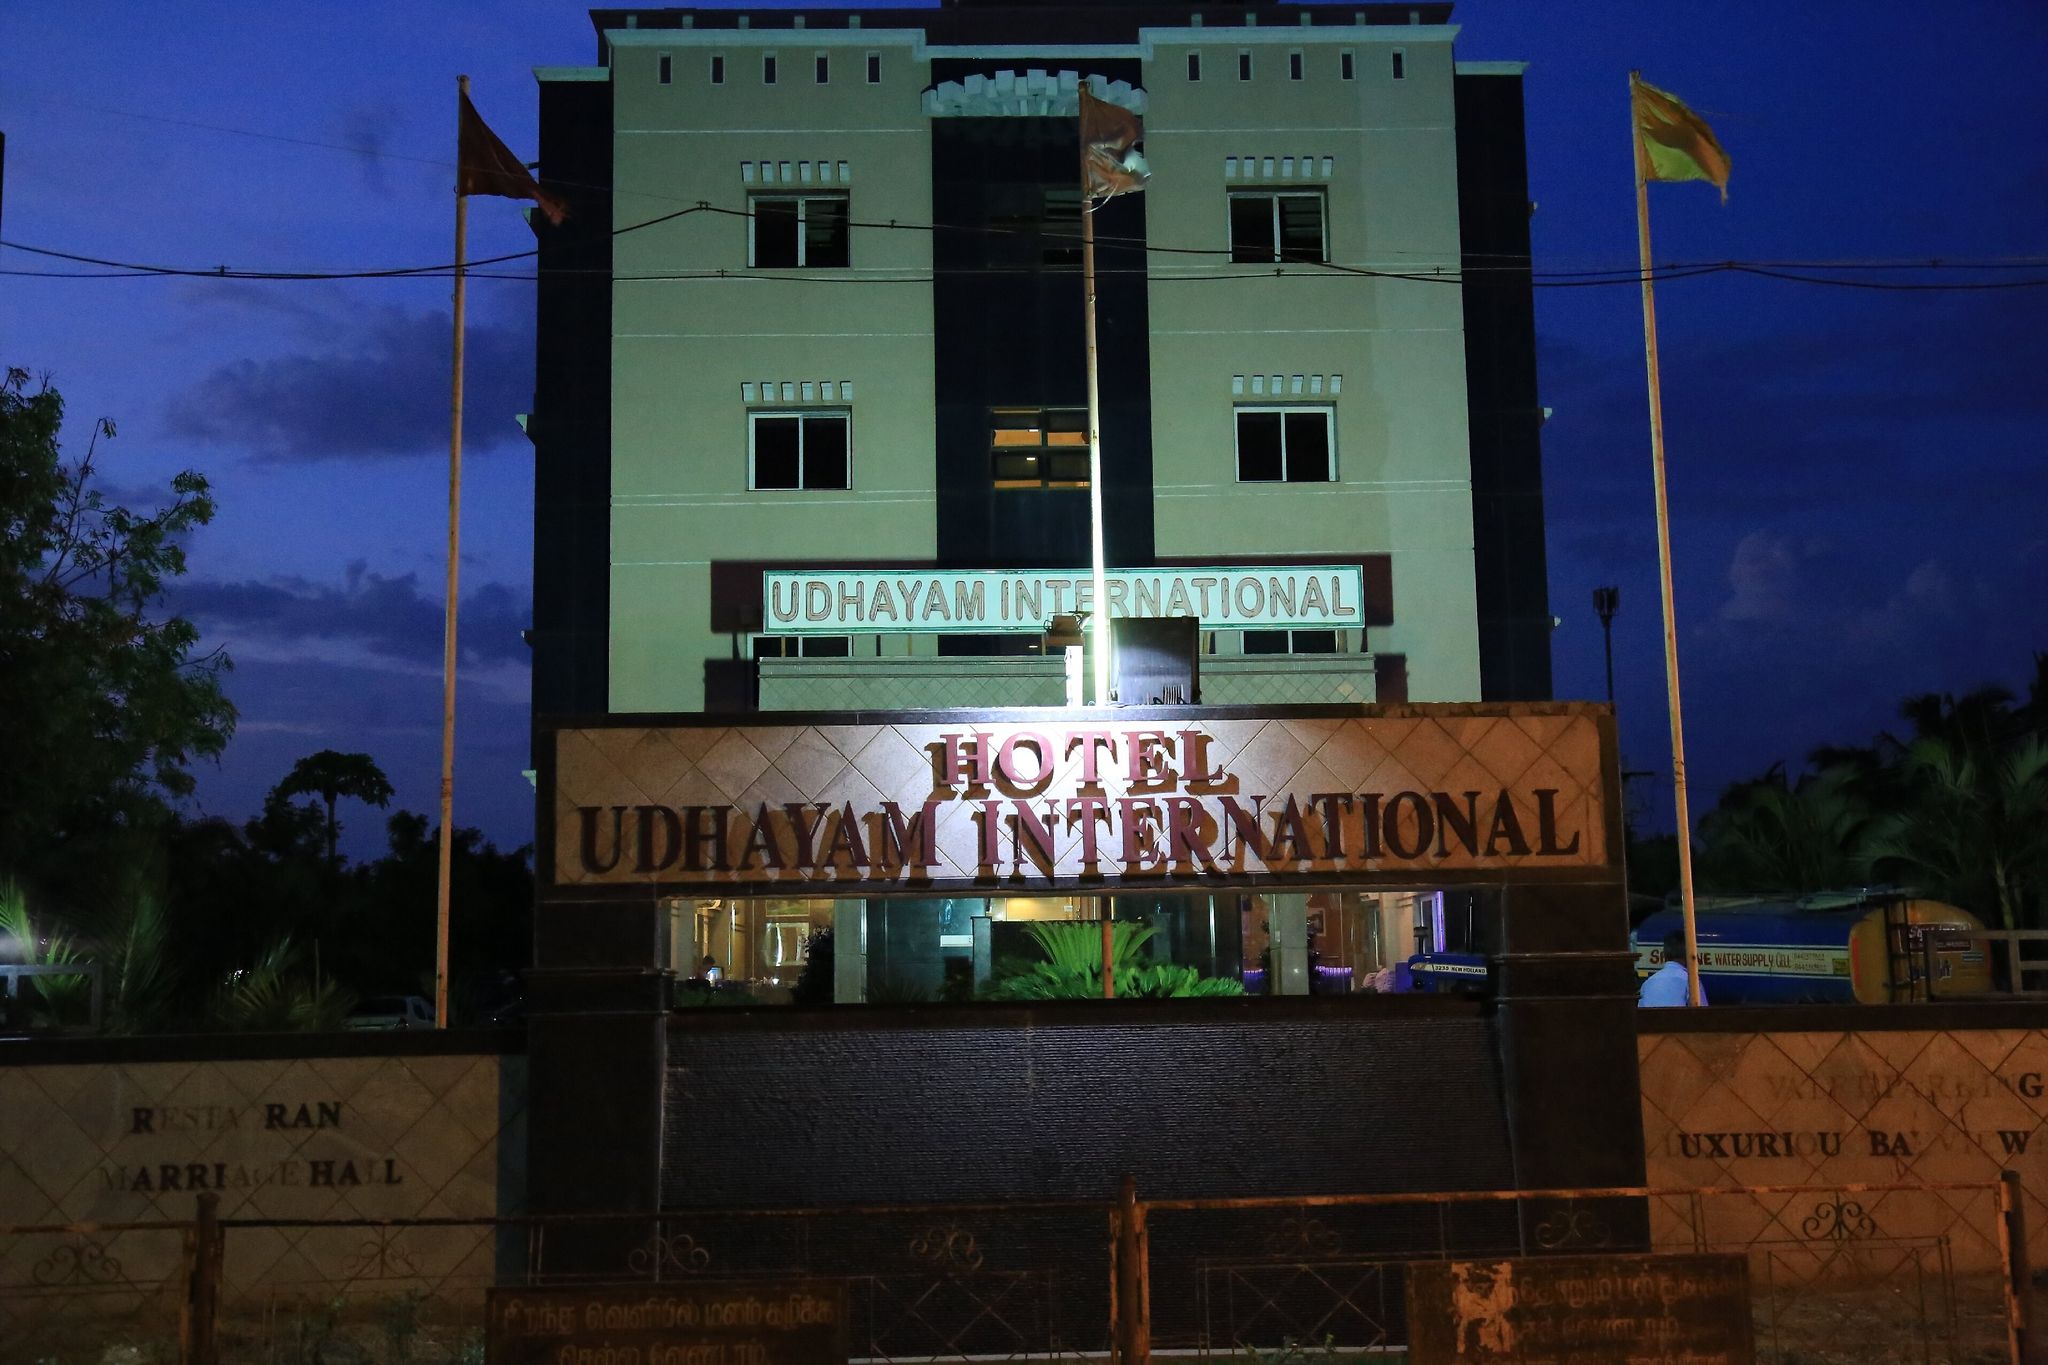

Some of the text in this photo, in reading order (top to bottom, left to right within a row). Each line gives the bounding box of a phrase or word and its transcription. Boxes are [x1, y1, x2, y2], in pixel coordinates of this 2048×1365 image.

[772, 576, 1356, 622] UDHAYAM INTERNATIONAL
[939, 731, 1223, 785] HOTEL
[577, 789, 1581, 875] UDHAYAM INTERNATIONAL
